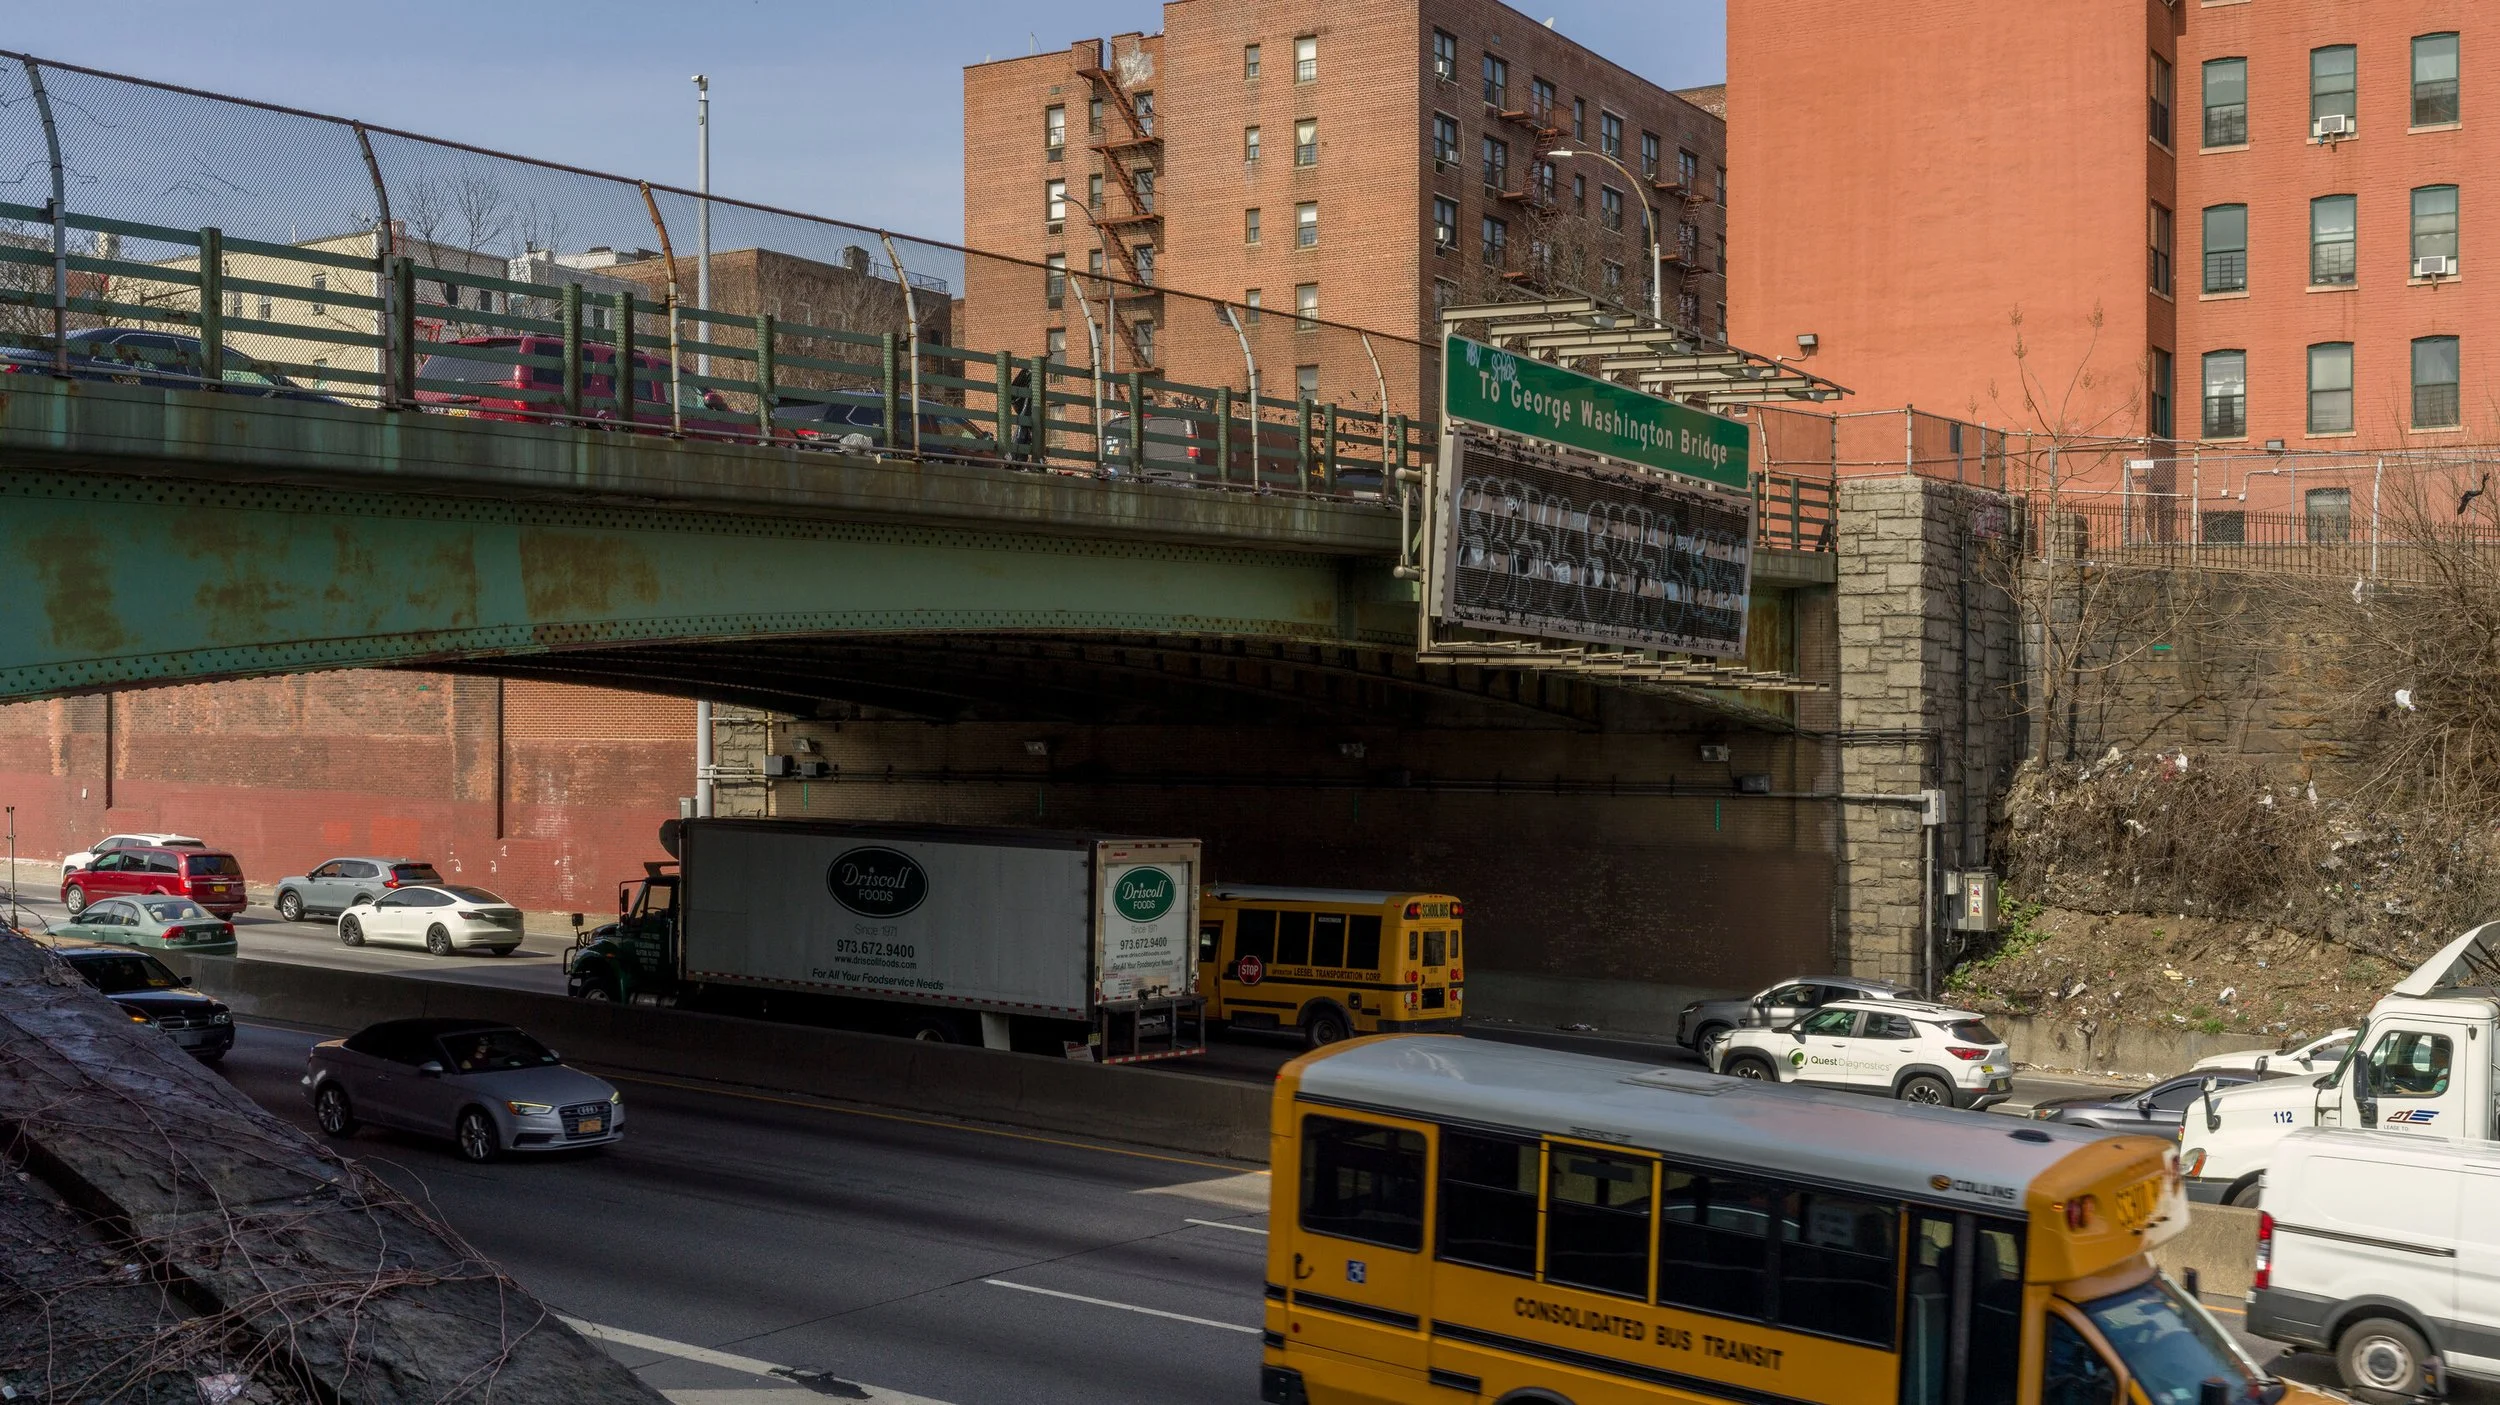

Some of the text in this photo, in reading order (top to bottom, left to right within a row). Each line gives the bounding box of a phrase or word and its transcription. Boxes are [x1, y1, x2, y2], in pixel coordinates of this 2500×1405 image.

[1479, 371, 1728, 470] To George Washington Bridge
[841, 863, 913, 889] Driscoll
[858, 888, 894, 902] FOODS
[1123, 880, 1167, 900] Driscoll
[1133, 899, 1156, 910] FOODS
[854, 923, 879, 936] Since
[837, 939, 915, 958] 973.672.9400
[1120, 937, 1168, 950] 973.672.9400
[834, 955, 917, 970] www.driscollfoods.com
[1241, 964, 1259, 976] STOP
[812, 968, 944, 990] For All Your Foodservice Needs
[1316, 970, 1363, 980] TRANSPORTATION
[1811, 1056, 1890, 1071] Quest Diagnostics
[2273, 1111, 2293, 1123] 112
[1952, 1179, 2017, 1199] COLLINS
[1514, 1297, 1784, 1370] CONSOLIDATED BUS TRANSIT
